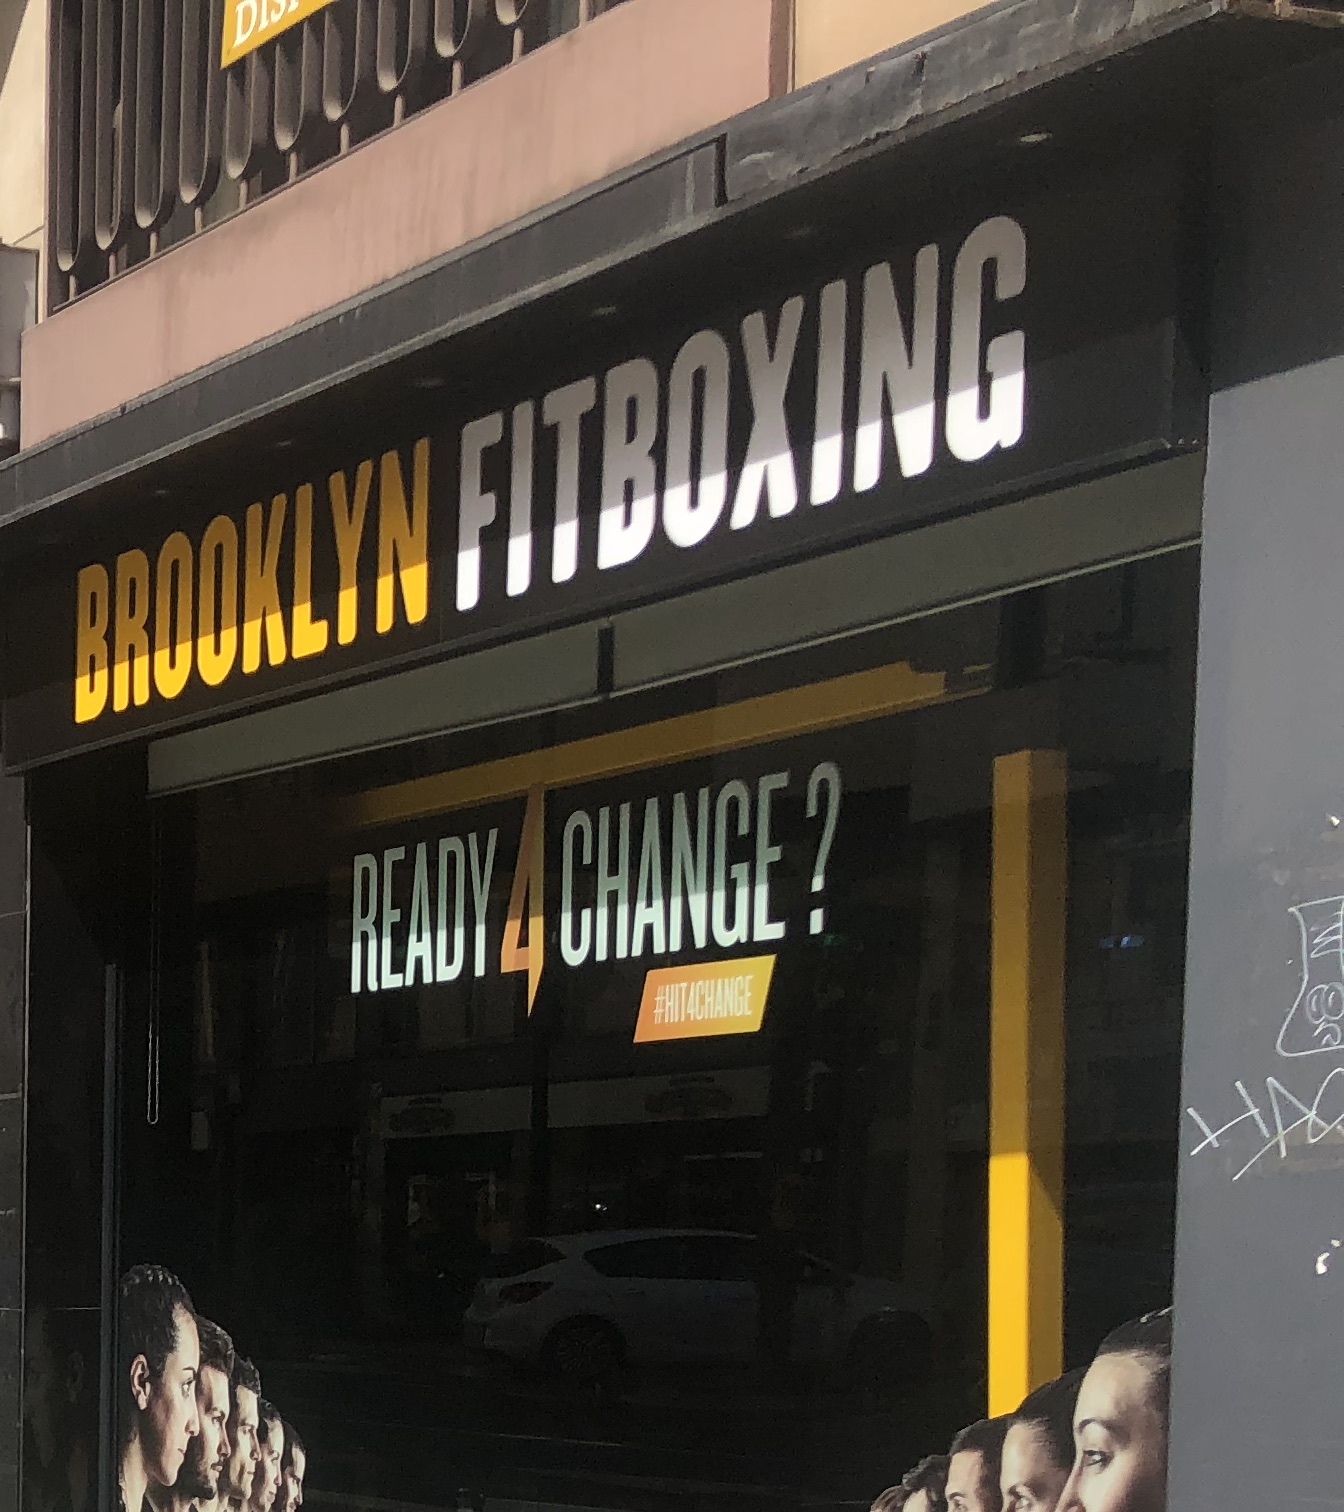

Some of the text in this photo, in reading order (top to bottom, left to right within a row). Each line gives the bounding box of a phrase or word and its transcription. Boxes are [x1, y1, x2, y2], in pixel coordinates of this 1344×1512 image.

[75, 215, 1028, 723] BROOKLYN FITBOXING
[350, 827, 500, 993] READY
[499, 784, 546, 1017] 4
[559, 773, 790, 967] CHANGE
[653, 975, 754, 1025] #HIT4CHANGE
